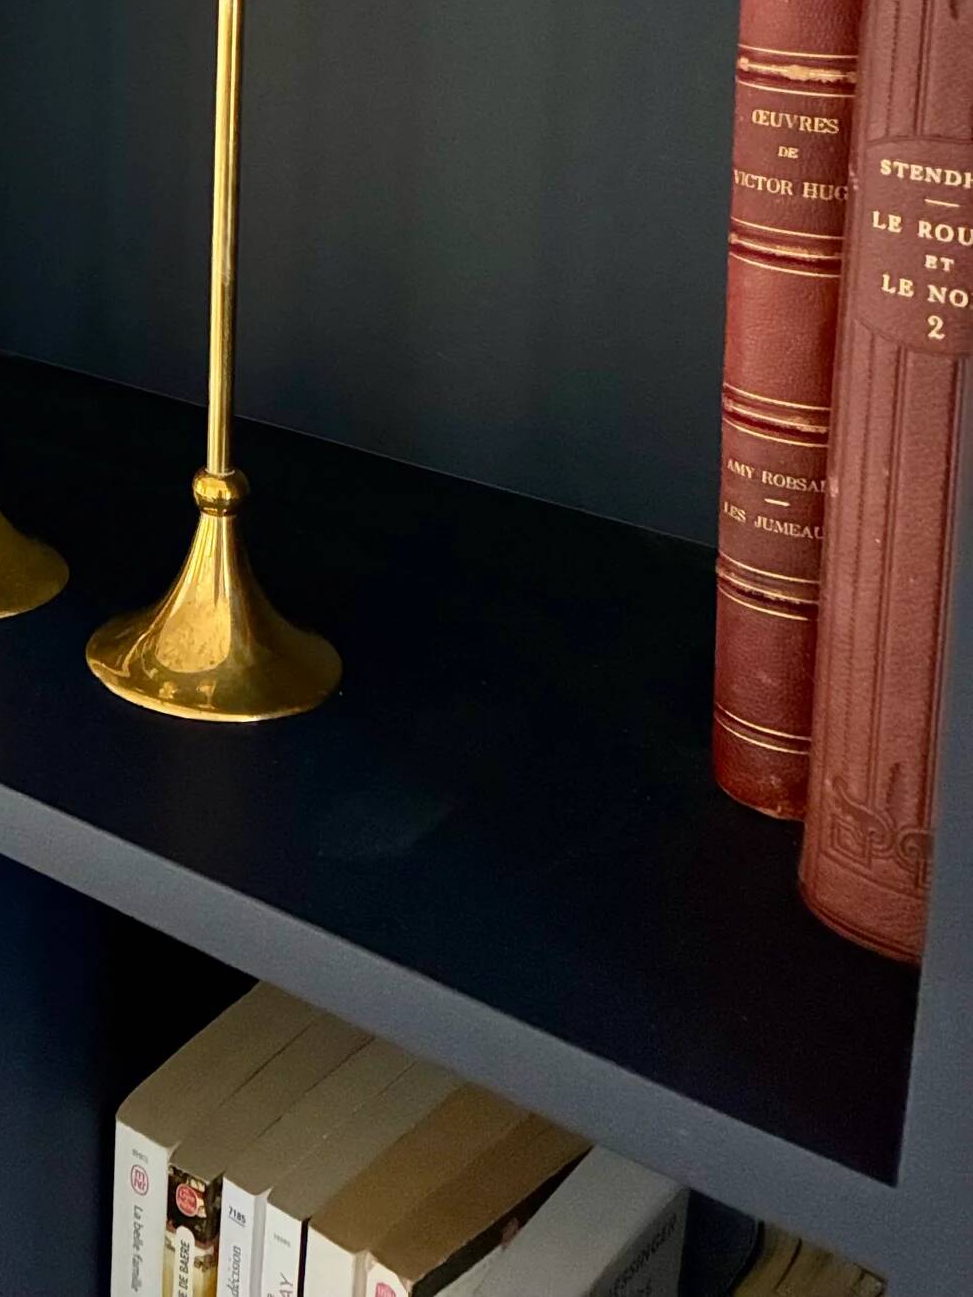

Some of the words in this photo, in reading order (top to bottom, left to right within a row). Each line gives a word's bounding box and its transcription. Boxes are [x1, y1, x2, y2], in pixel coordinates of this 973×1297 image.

[751, 109, 839, 135] ŒUVRES
[777, 145, 799, 159] DE
[872, 210, 903, 234] LE
[917, 219, 973, 247] ROU
[924, 254, 955, 272] ET
[881, 273, 914, 298] LE
[927, 314, 946, 340] 2
[726, 458, 755, 479] AMY
[723, 501, 747, 523] LES
[132, 1205, 145, 1221] La
[228, 1205, 247, 1225] 7185
[132, 1221, 144, 1253] belle
[178, 1239, 191, 1275] BAERE
[178, 1273, 190, 1293] DE
